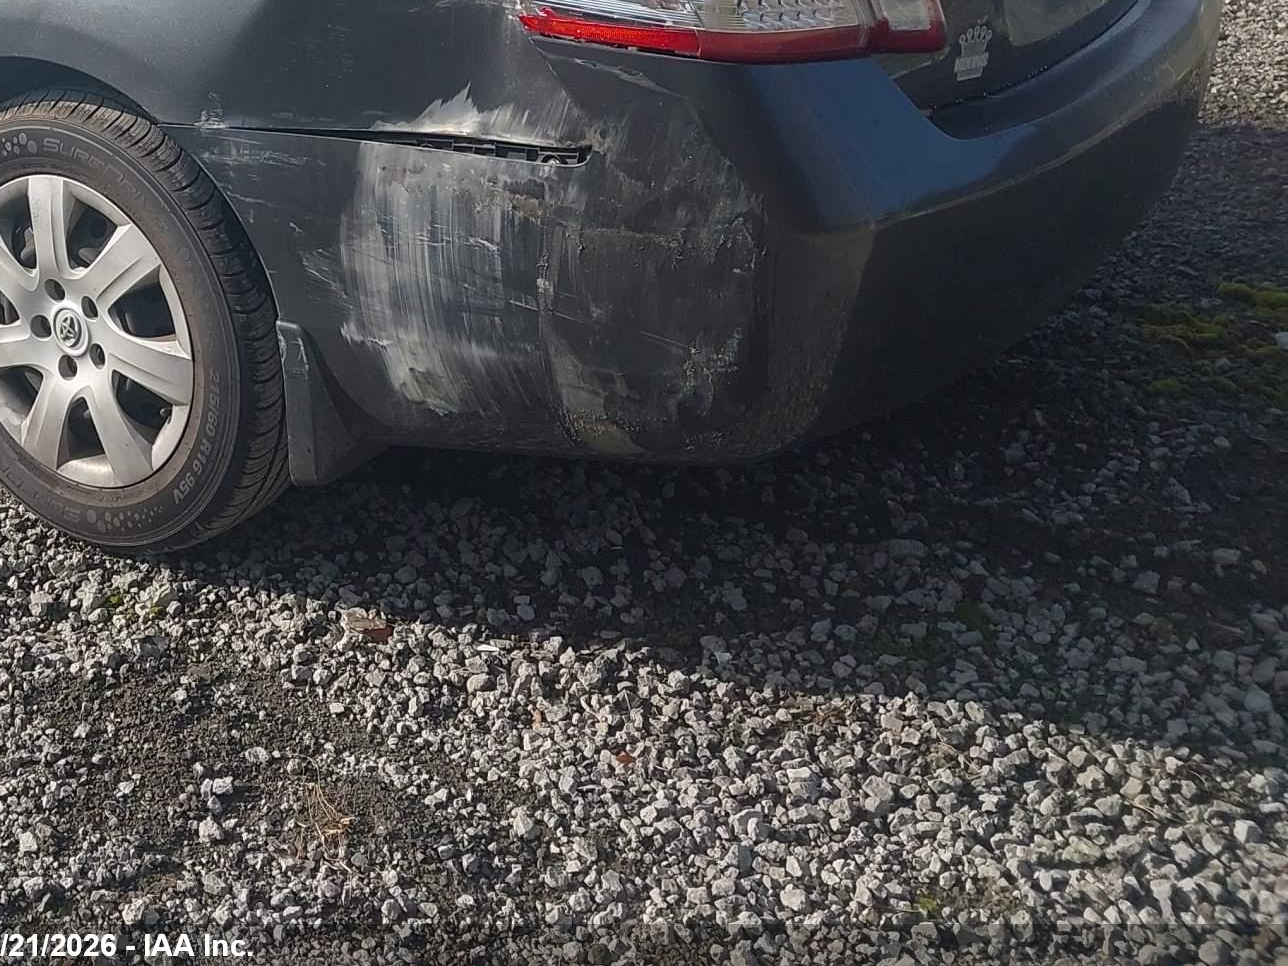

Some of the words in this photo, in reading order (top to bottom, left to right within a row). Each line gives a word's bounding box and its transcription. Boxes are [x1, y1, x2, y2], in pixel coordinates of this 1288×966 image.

[206, 371, 221, 438] 215/60
[193, 438, 212, 475] R16
[173, 472, 196, 505] 95V
